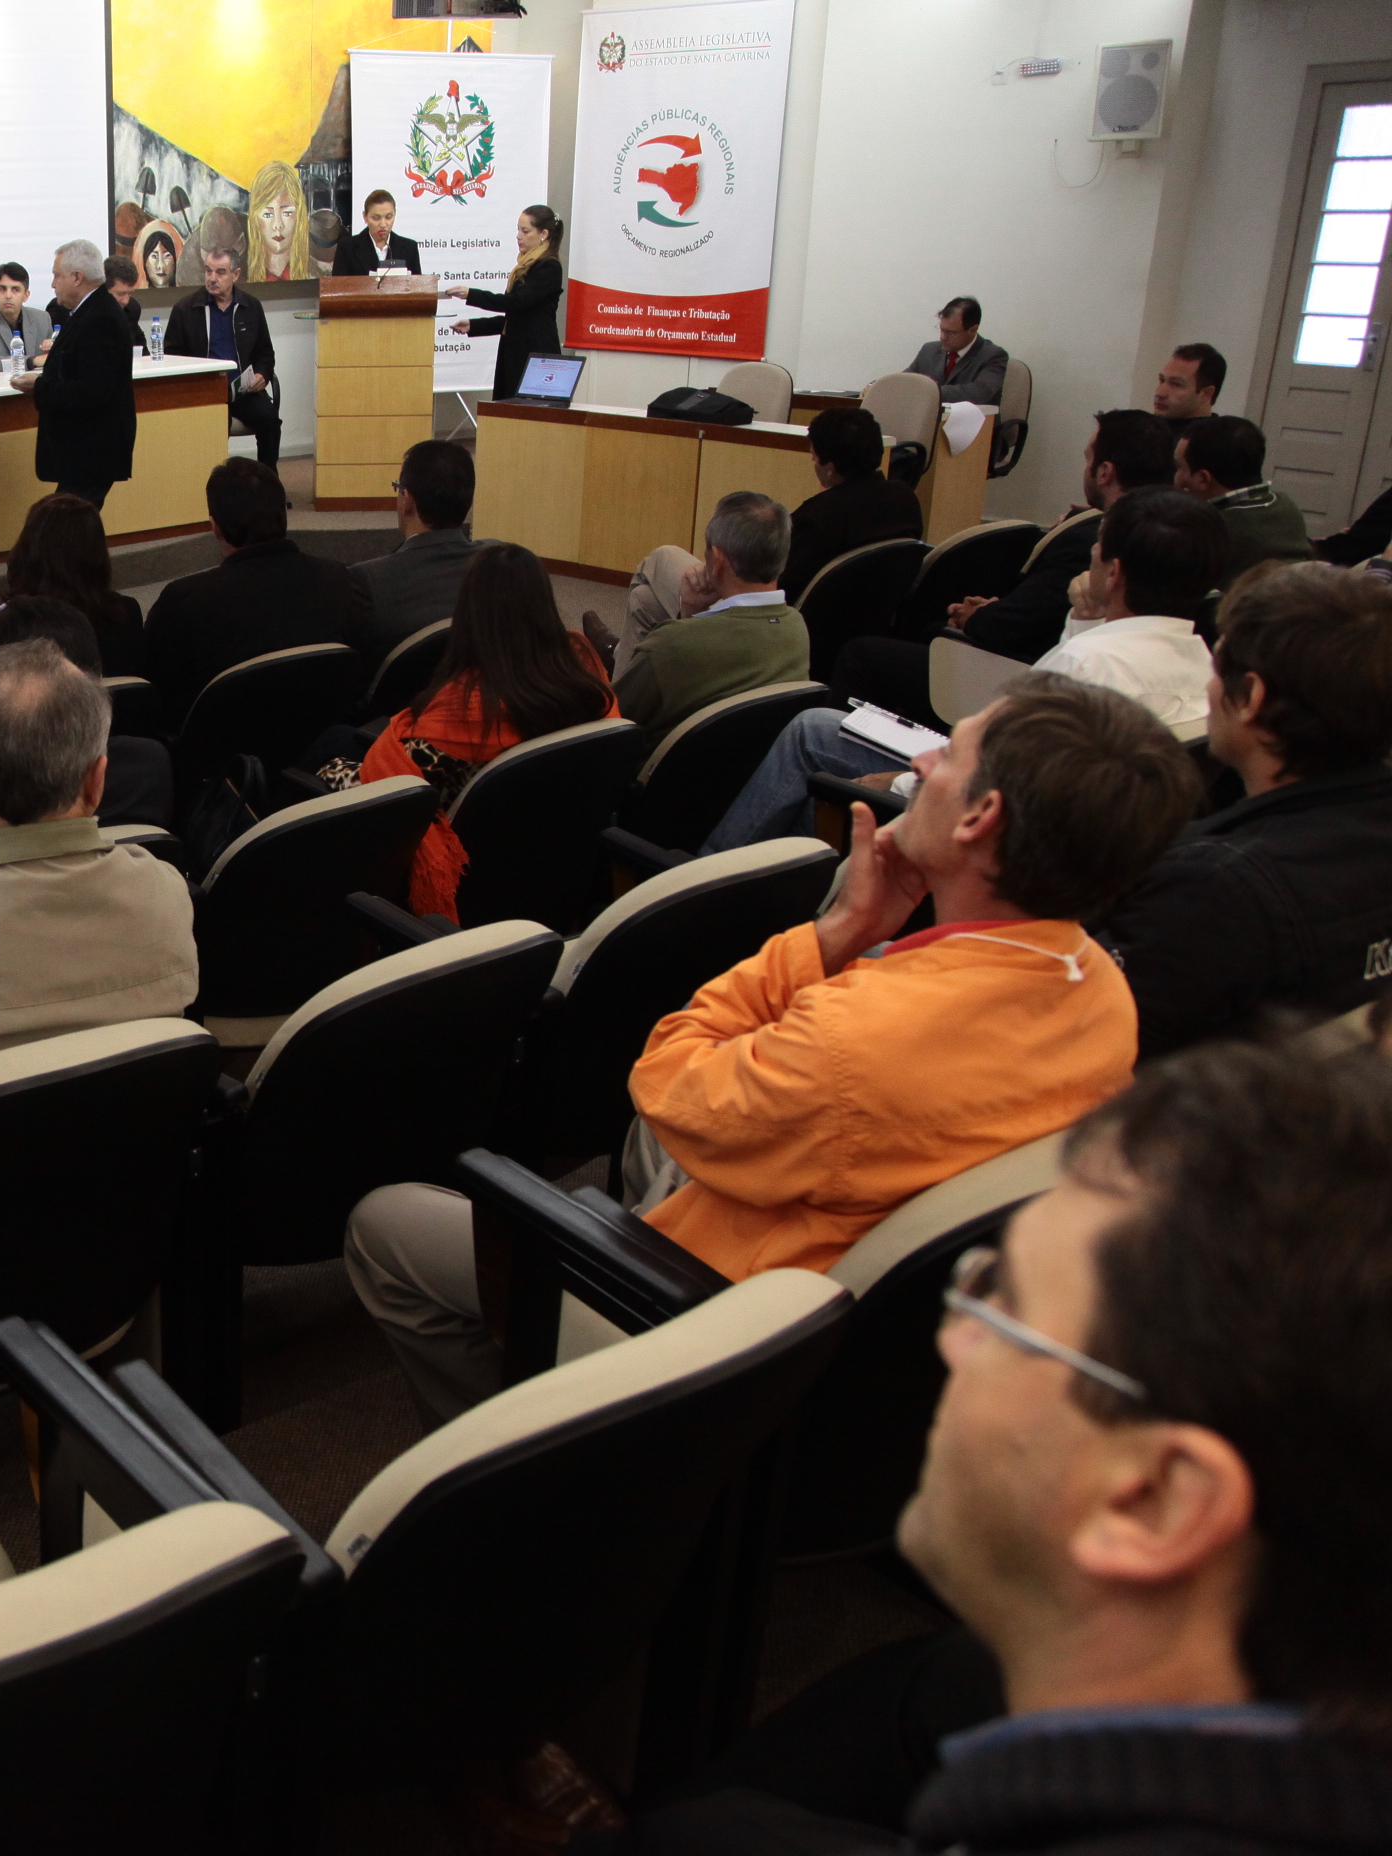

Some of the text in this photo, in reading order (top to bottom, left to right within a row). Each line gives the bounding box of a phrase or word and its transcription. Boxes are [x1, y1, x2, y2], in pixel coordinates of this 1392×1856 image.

[631, 31, 771, 51] ASSEMBLEIA LEGISLATIVA
[629, 50, 771, 68] DO ESTADO DE SANTA CATARINA
[613, 108, 735, 195] AUDIÊNCIAS PÚBLICAS REGIONAIS
[417, 238, 501, 250] mbleia Legislativa
[620, 223, 714, 258] ORÇAMENTO REGIONALIZADO
[444, 271, 471, 280] Santa
[597, 303, 633, 315] Comissão
[634, 305, 644, 316] de
[647, 305, 681, 319] Finanças
[688, 308, 730, 321] Tributação
[437, 327, 449, 336] de
[589, 324, 737, 343] Coordenadoria do Orçamento Estadual
[434, 343, 471, 353] butação
